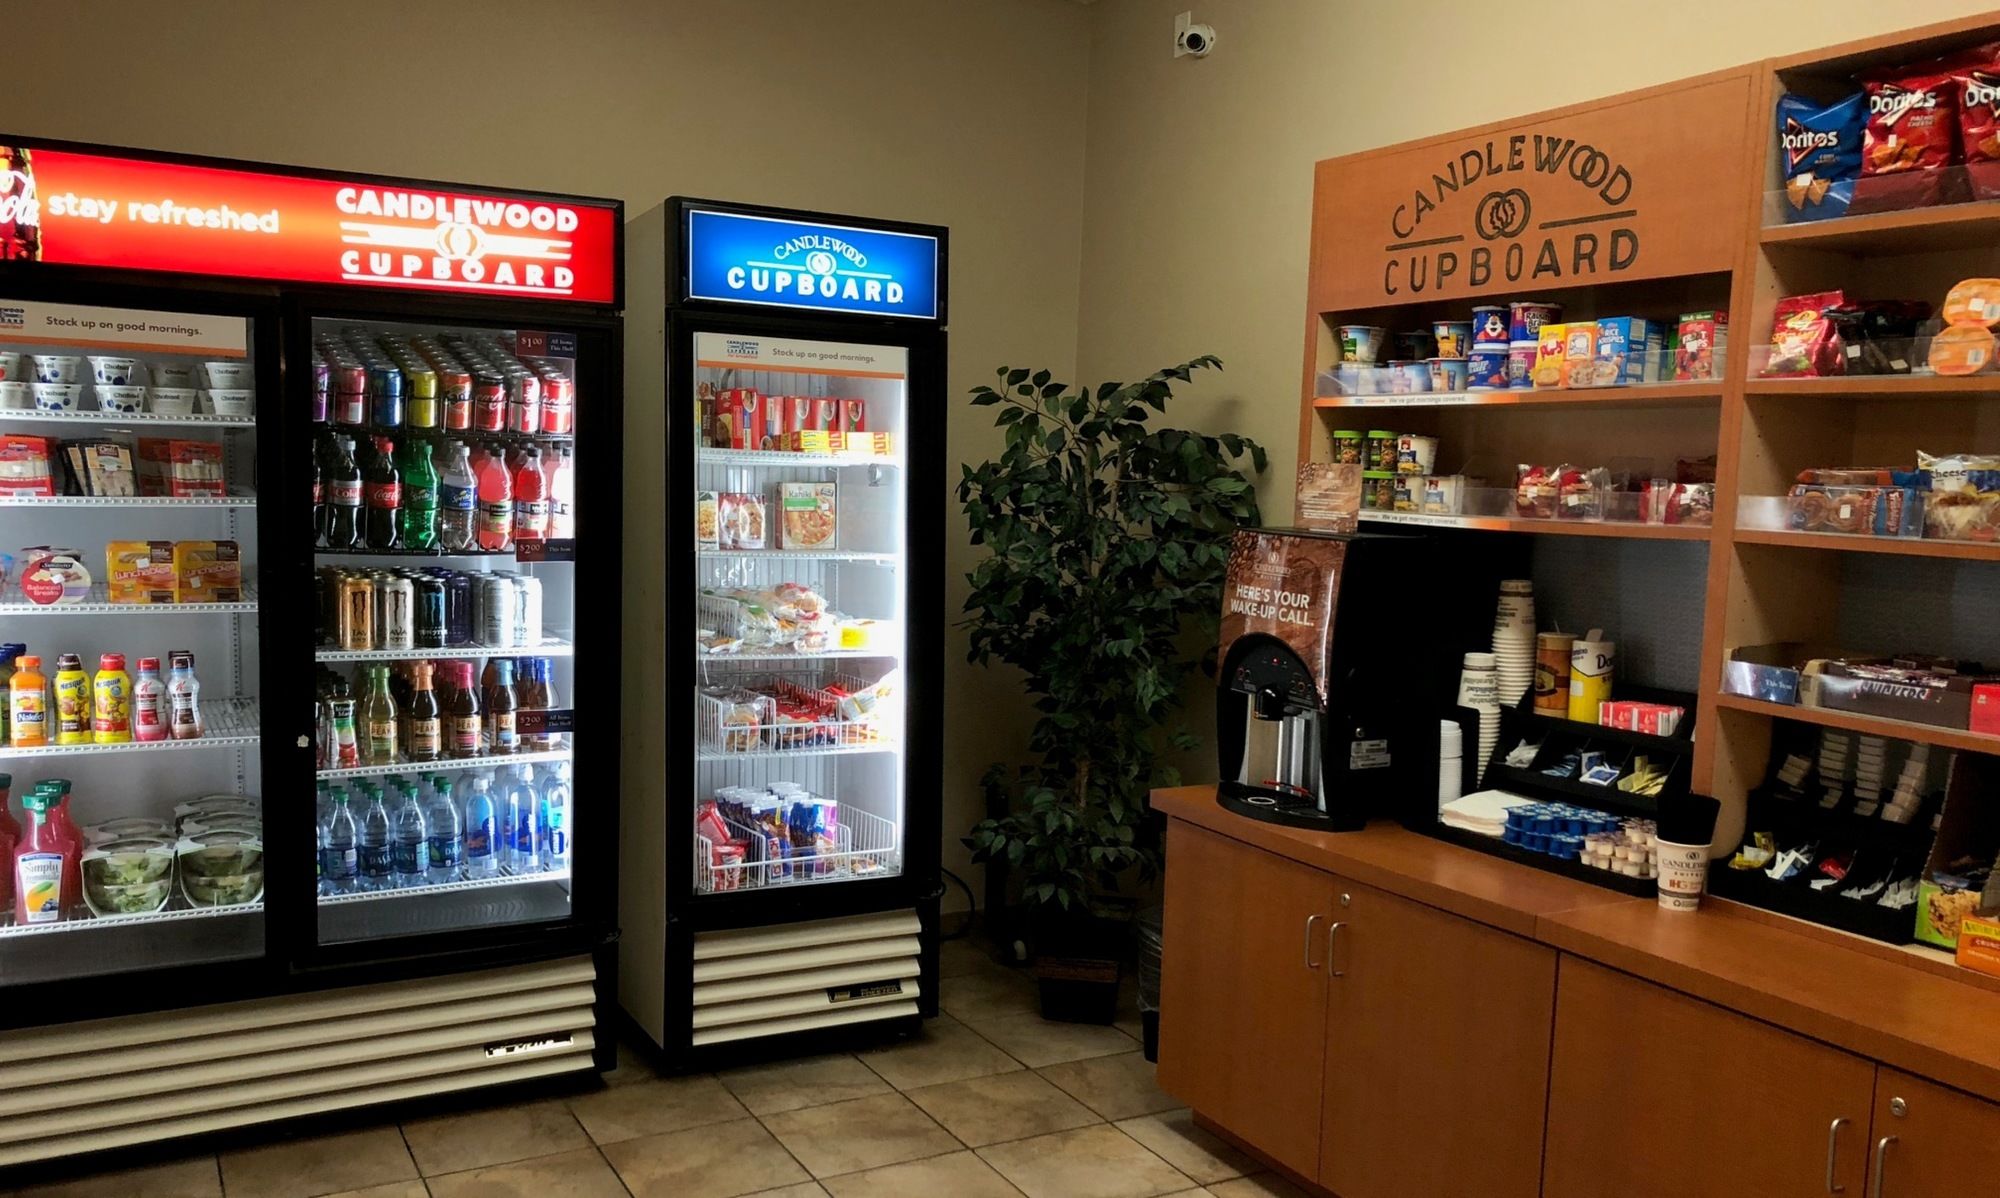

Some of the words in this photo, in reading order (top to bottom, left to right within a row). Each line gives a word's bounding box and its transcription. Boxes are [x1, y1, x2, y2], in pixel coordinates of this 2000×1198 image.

[1870, 90, 1936, 114] Doritos
[1392, 134, 1632, 239] CANDLEWOOD
[48, 192, 118, 224] stay
[128, 199, 280, 234] refreshed
[336, 187, 578, 233] CANDLEWOOD
[774, 235, 868, 269] CANDLEWOOD
[1384, 228, 1639, 295] CUPBOARD
[340, 250, 575, 288] CUPBOARD
[726, 266, 904, 304] CUPBOARD
[46, 315, 78, 328] Stock
[81, 319, 97, 330] up
[99, 320, 114, 329] on
[117, 320, 146, 333] good
[149, 325, 203, 337] mornings.
[772, 347, 794, 357] Stock
[796, 351, 807, 360] up
[819, 352, 839, 362] good
[840, 355, 876, 364] mornings.
[1236, 584, 1271, 603] HERE'S
[1273, 590, 1310, 609] YOUR
[1230, 598, 1276, 620] WAKE-UP
[1278, 607, 1315, 627] CALL.
[25, 861, 59, 876] Simply
[1669, 879, 1689, 889] IHG
